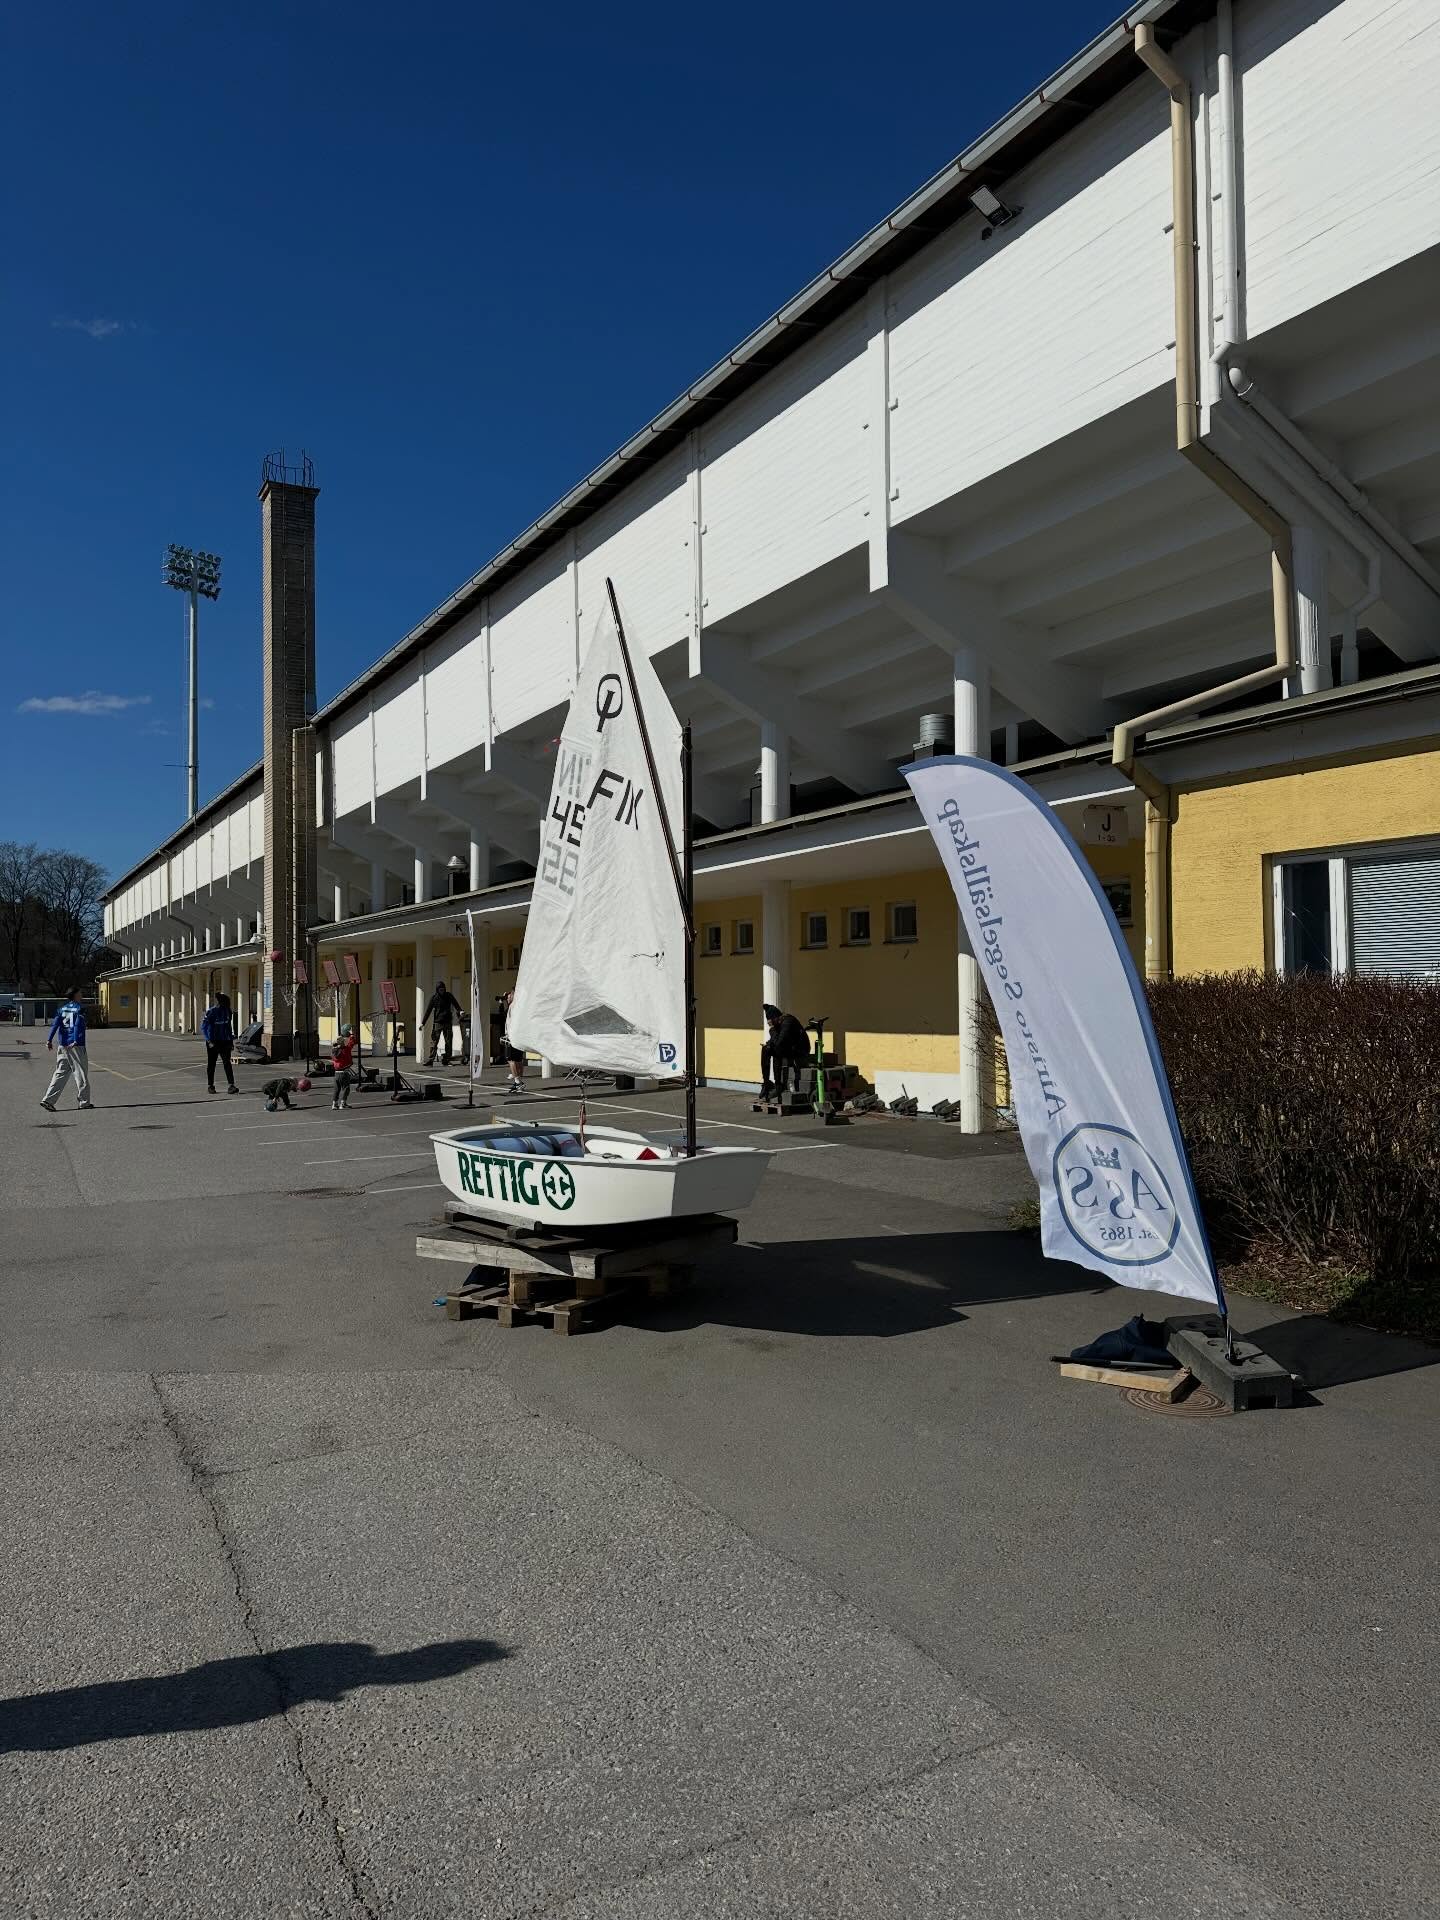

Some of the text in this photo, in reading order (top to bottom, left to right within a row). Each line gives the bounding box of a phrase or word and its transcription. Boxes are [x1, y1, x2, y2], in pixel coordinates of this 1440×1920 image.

[1101, 813, 1111, 832] J
[455, 923, 463, 932] K
[457, 1150, 540, 1205] RETTIG
